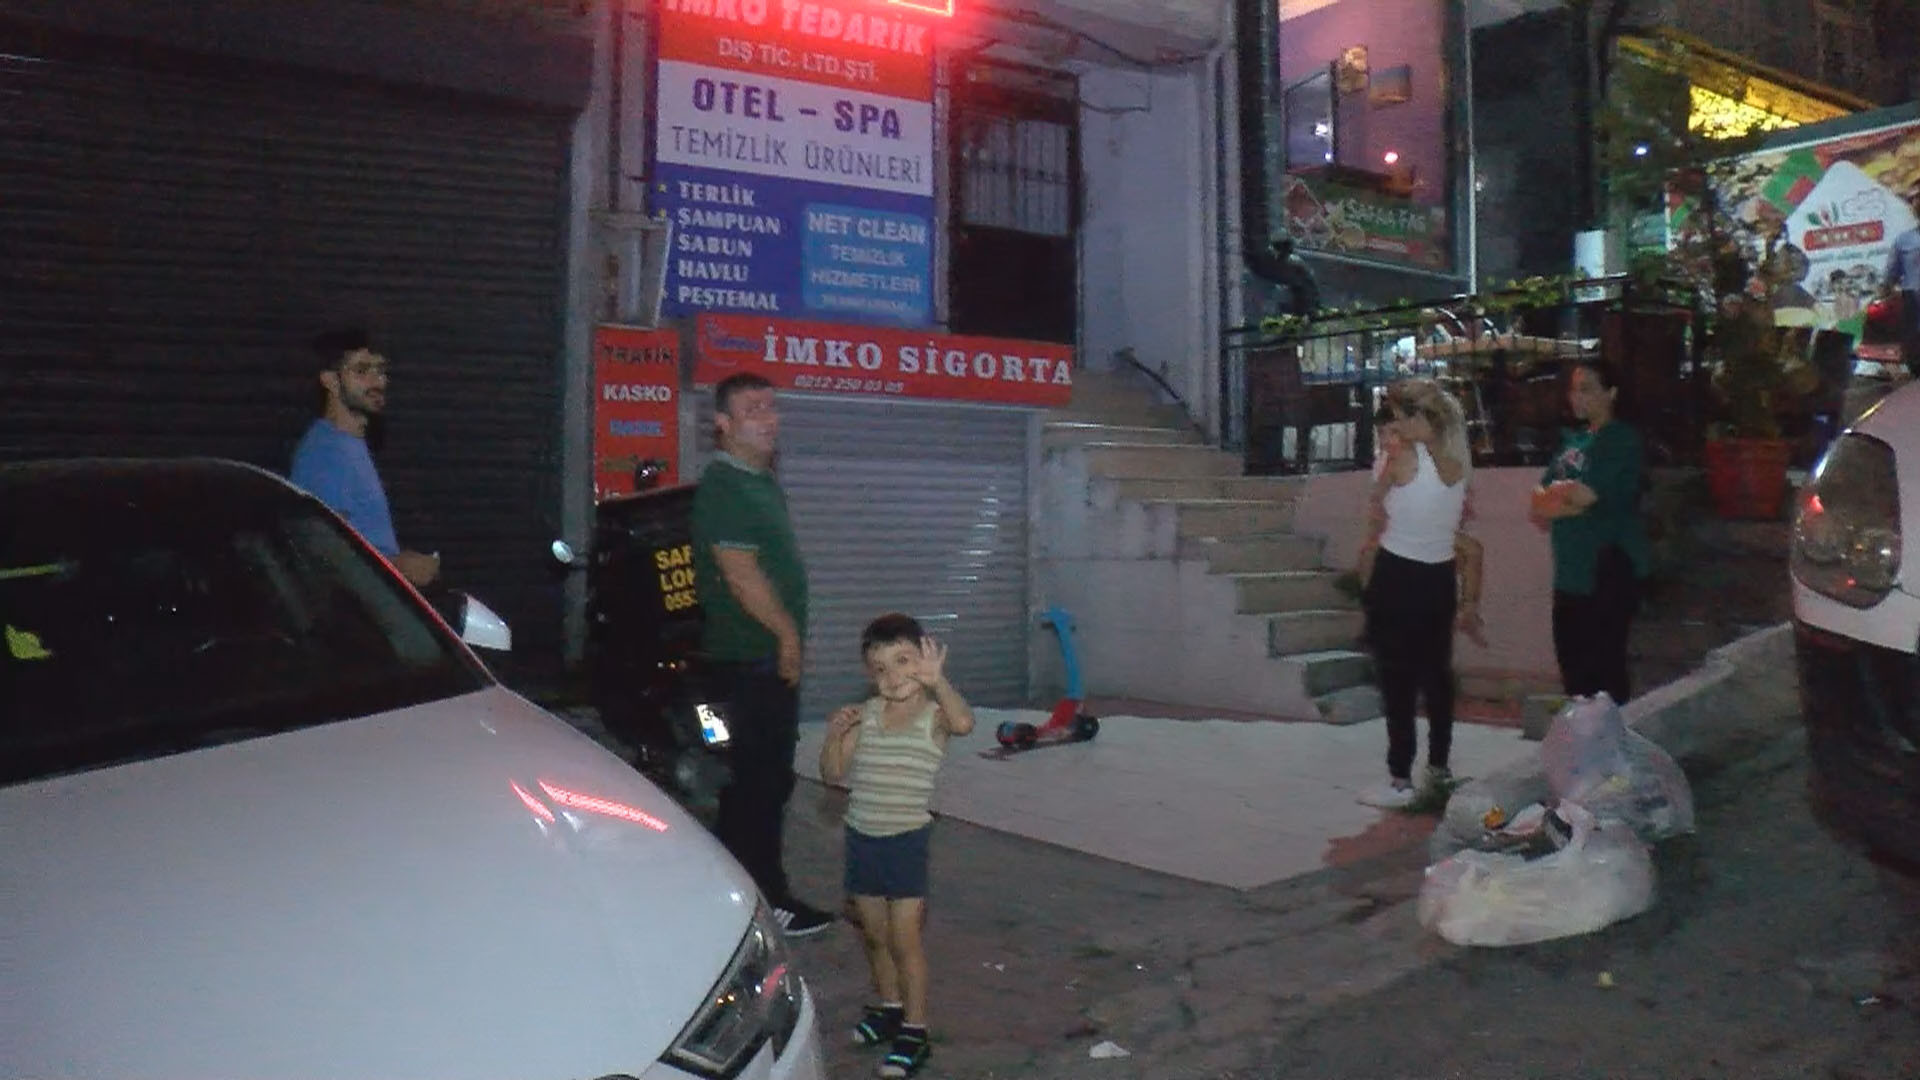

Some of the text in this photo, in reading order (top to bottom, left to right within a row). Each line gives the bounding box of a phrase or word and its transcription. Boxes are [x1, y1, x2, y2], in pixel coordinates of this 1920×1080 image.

[780, 1, 928, 55] TEDARİK
[693, 78, 785, 122] OTEL
[834, 99, 902, 140] SPA
[671, 125, 922, 184] TEMİZLİK ÜRÜNLERİ
[678, 180, 755, 207] TERLİK
[678, 207, 781, 235] ŞAMPUAN
[807, 211, 927, 245] NET CLEAN
[678, 233, 753, 257] SABUN
[678, 259, 749, 281] HAVLU
[678, 285, 780, 311] PEŞTEMAL
[763, 326, 1073, 385] İMKO SİGORTA
[602, 383, 673, 403] KASKO
